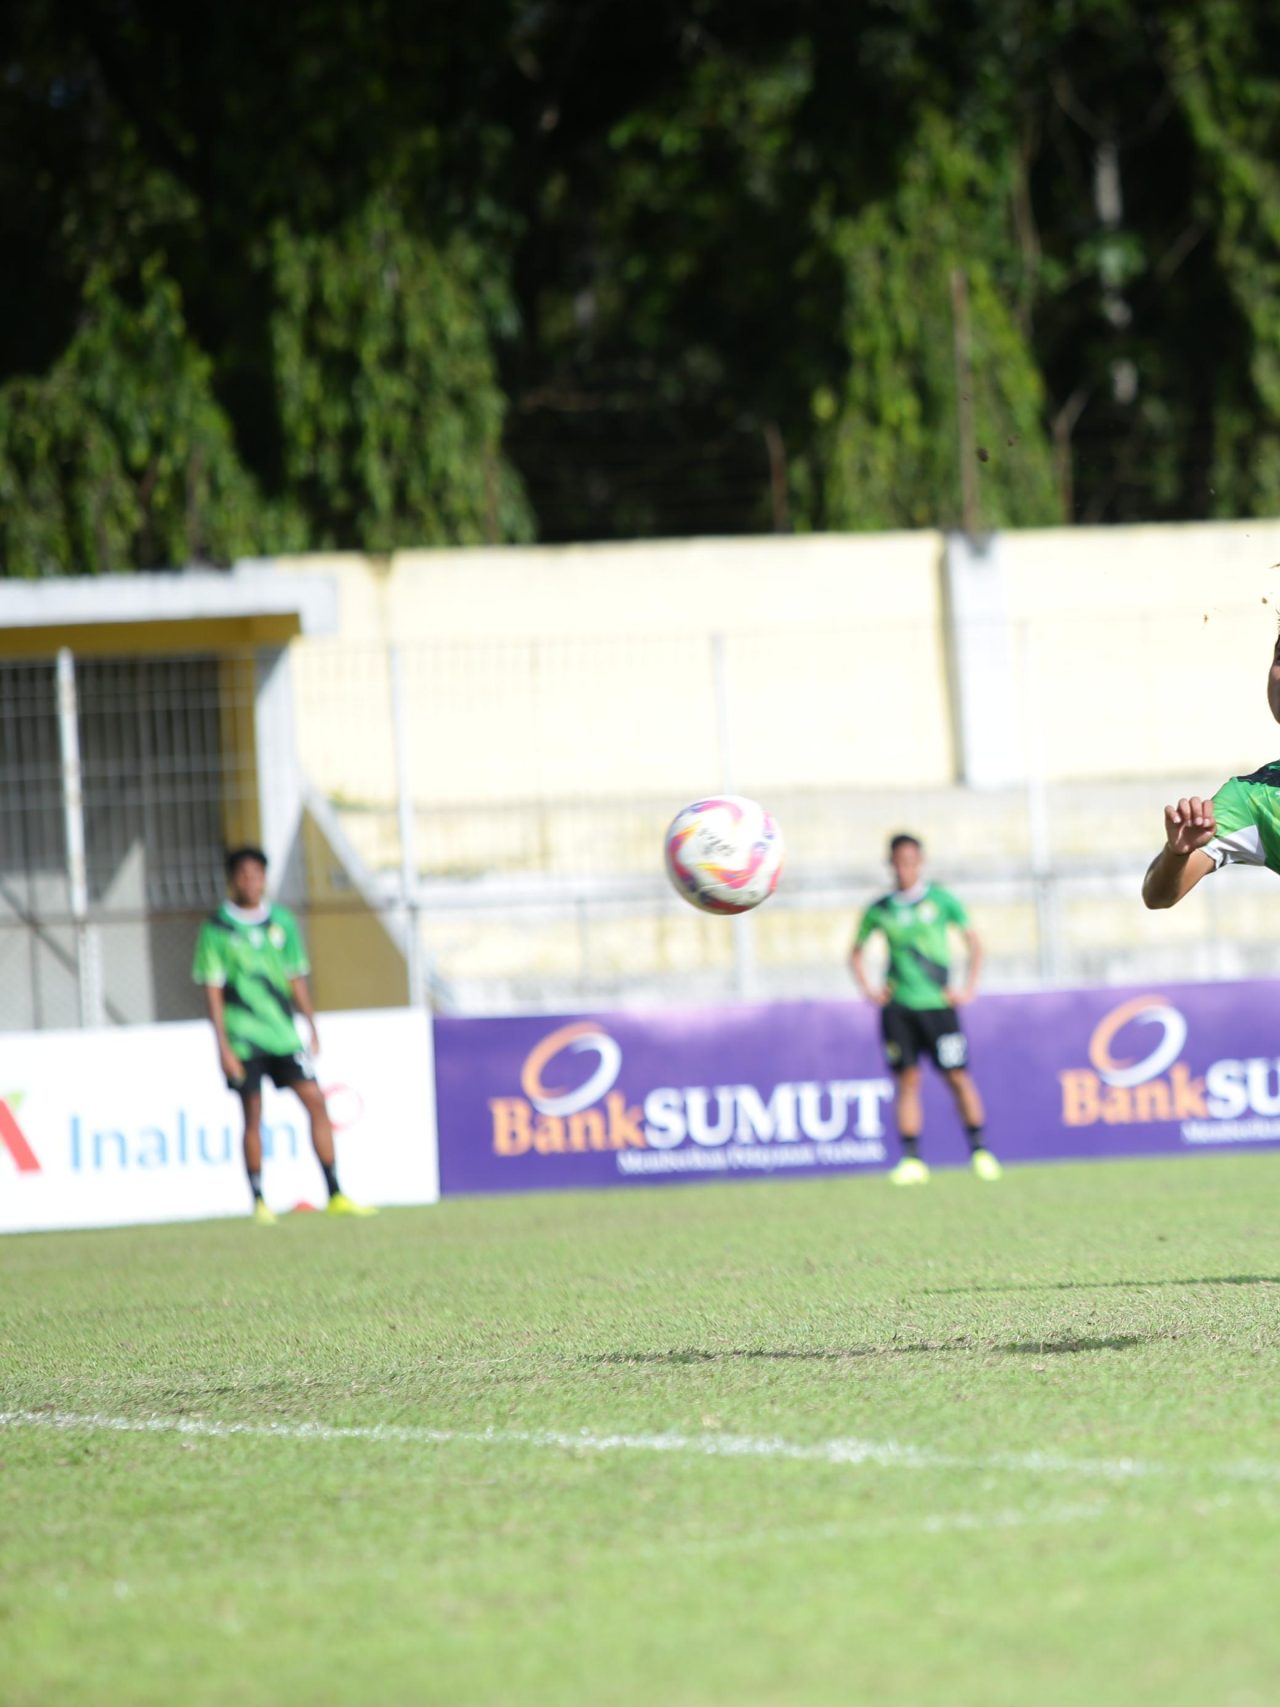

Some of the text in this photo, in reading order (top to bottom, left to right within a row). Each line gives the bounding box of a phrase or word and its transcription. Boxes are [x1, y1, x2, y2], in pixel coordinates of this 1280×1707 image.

[490, 1079, 893, 1155] Bank SUMUT
[1060, 1063, 1209, 1126] Bank
[70, 1108, 299, 1172] Inalum
